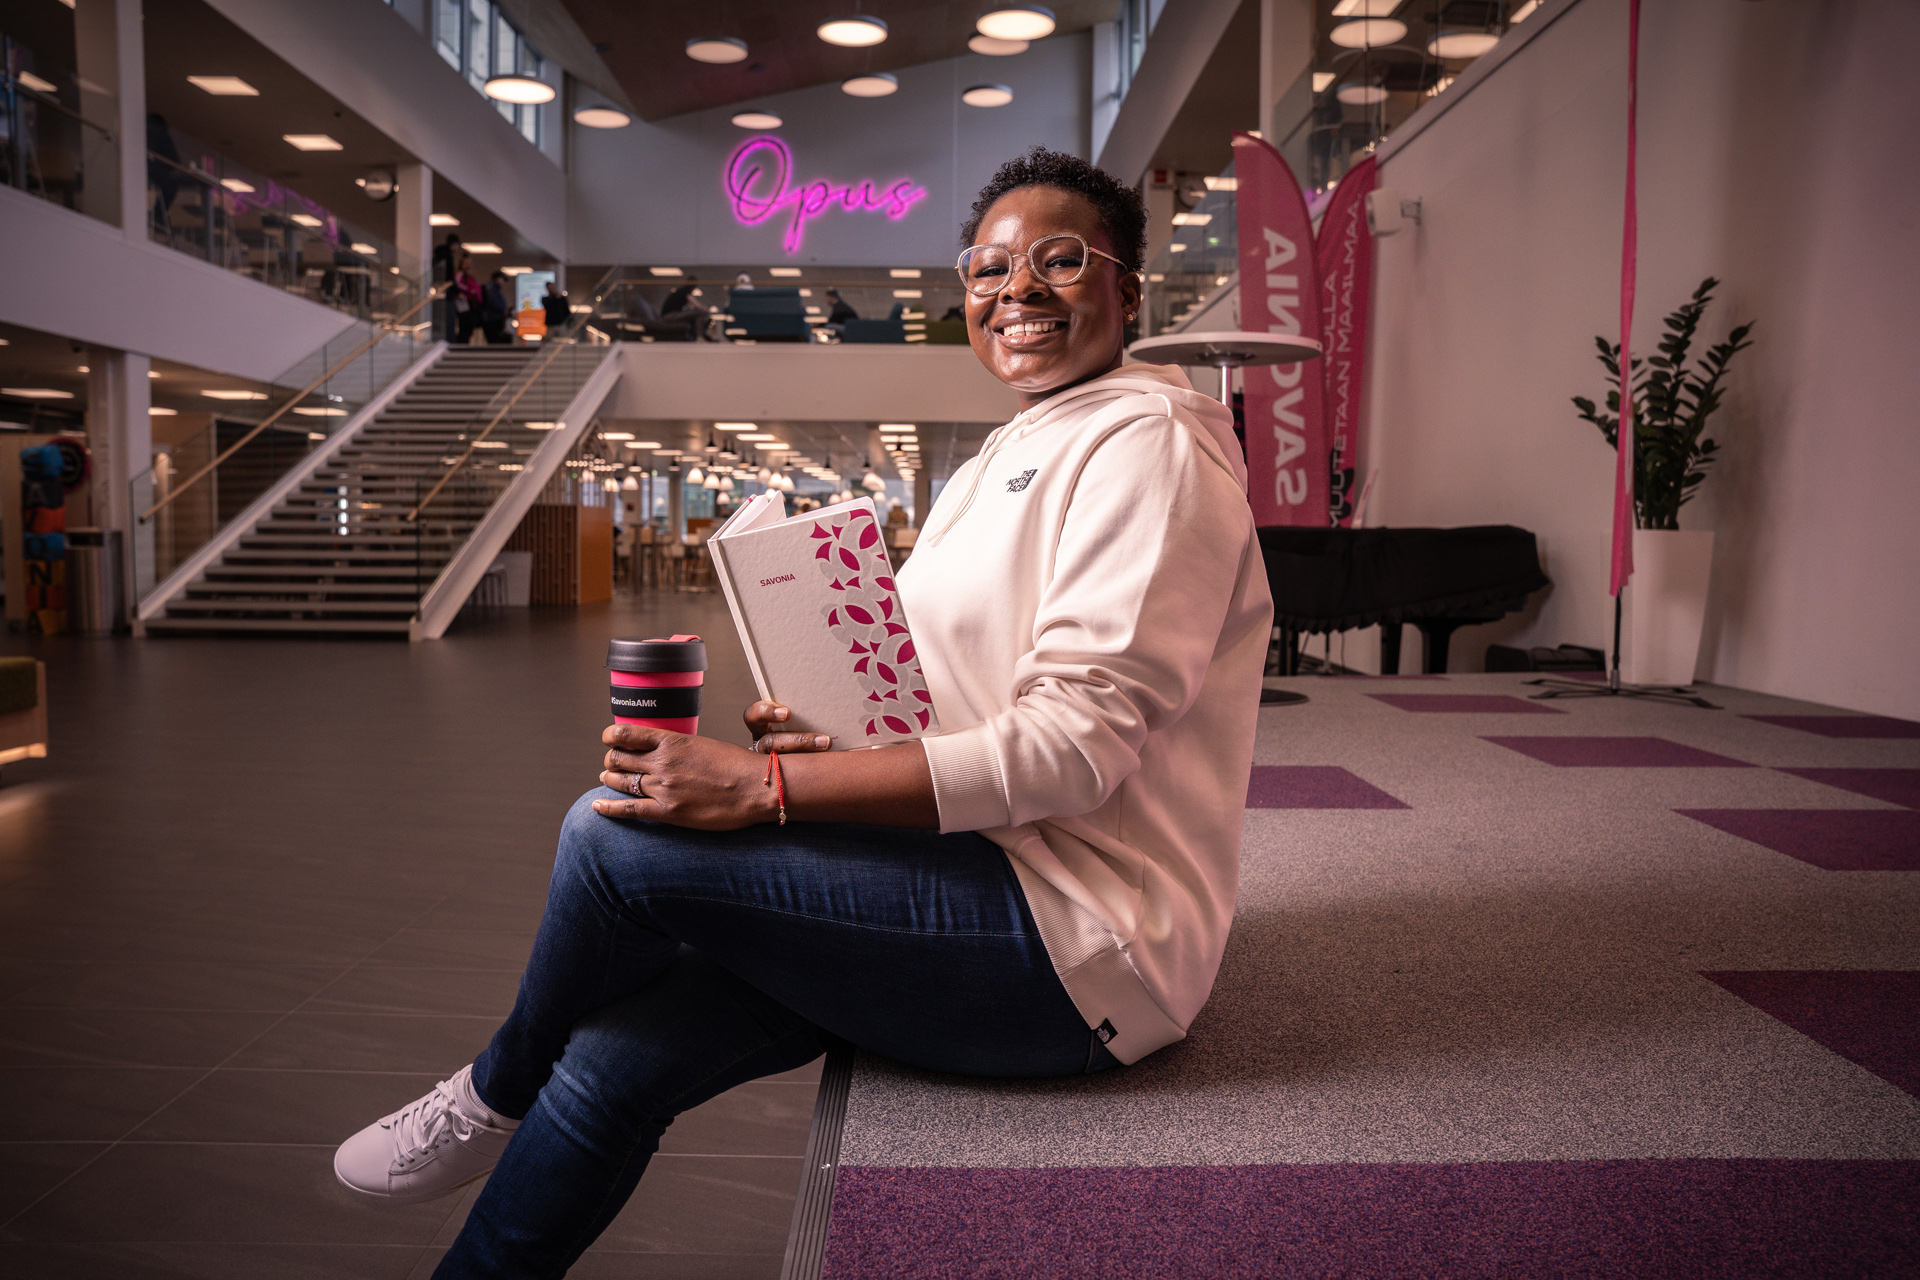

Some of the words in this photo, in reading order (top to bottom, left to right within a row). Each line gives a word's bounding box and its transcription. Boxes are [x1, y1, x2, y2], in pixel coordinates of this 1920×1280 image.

[725, 136, 926, 254] Opus
[1329, 360, 1351, 529] MUUTETAAN
[1021, 469, 1034, 477] THE
[1006, 477, 1028, 485] NORTH
[1006, 484, 1025, 492] FACE
[760, 573, 796, 587] SAVONIA
